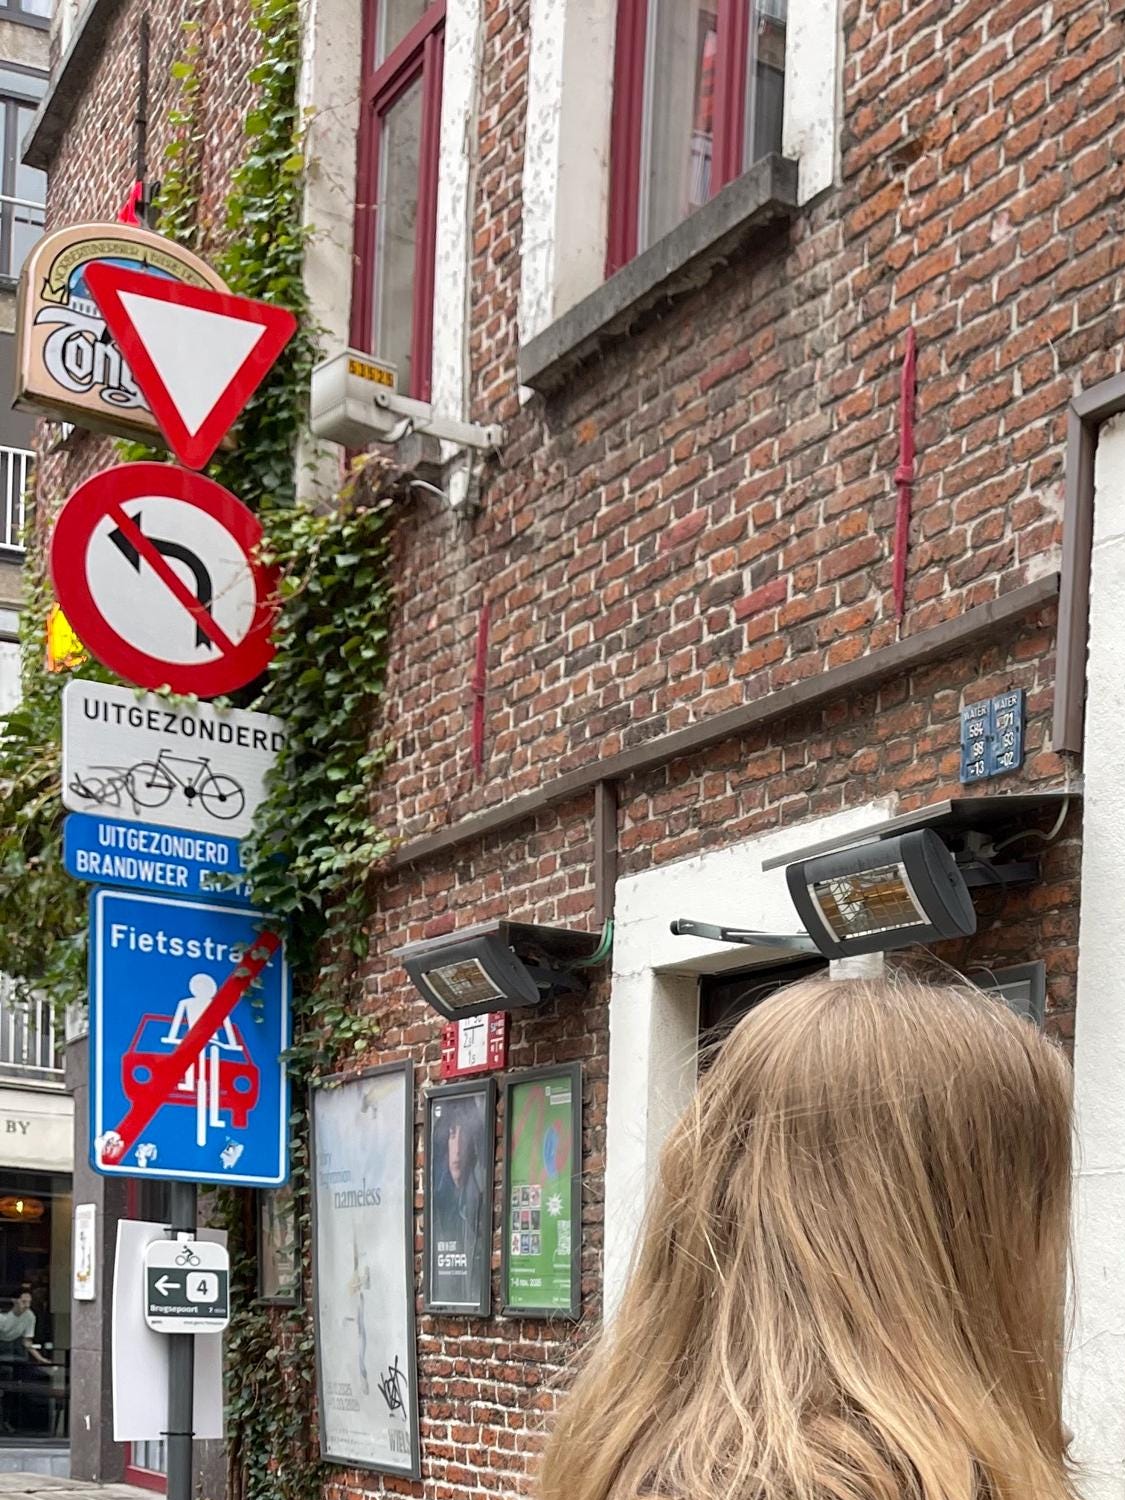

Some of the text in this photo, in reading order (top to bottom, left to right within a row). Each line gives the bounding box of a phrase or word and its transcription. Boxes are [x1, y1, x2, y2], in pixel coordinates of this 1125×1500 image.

[963, 705, 987, 720] WATER
[994, 695, 1017, 711] WATER
[84, 698, 286, 752] UITGEZONDERD
[98, 823, 229, 865] UITGEZONDERD
[76, 849, 188, 888] BRANDWEER
[110, 923, 274, 967] Fietsstra
[5, 1120, 31, 1135] BY
[334, 1177, 381, 1209] nameless
[196, 1279, 208, 1295] 4
[150, 1304, 198, 1314] Brugsepoort
